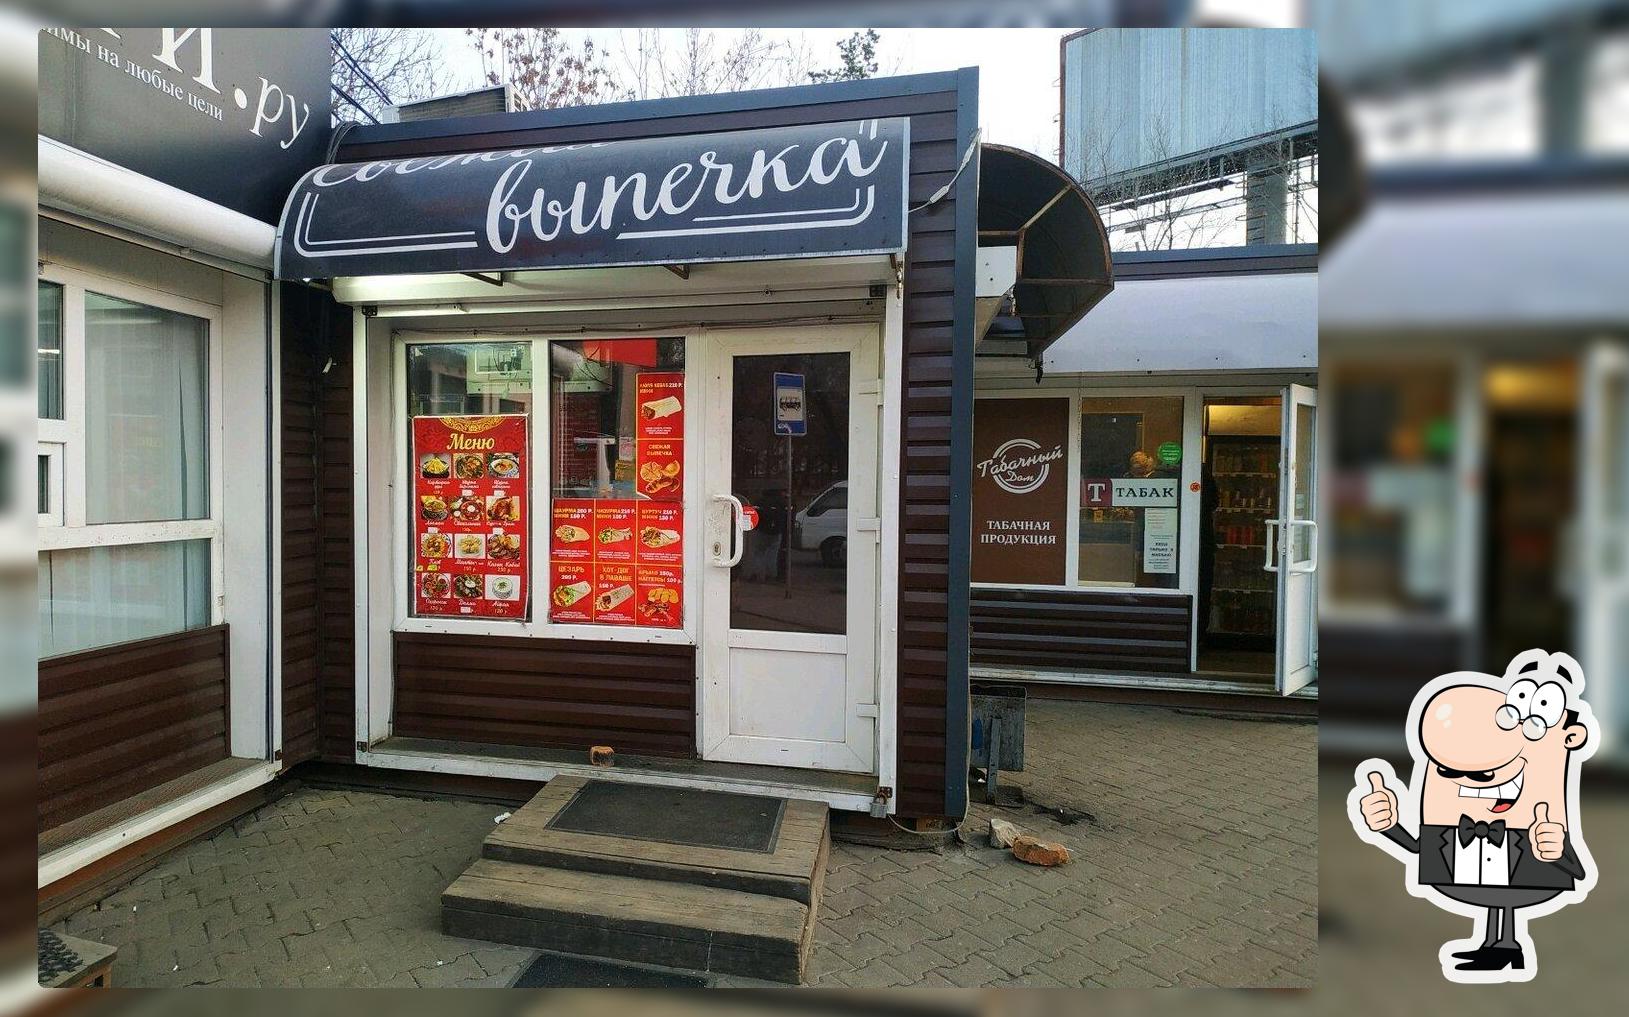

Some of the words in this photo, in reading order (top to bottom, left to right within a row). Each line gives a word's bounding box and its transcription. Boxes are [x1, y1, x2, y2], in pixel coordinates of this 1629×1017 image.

[97, 44, 120, 68] на
[125, 60, 184, 100] любые
[187, 91, 223, 122] цели
[447, 433, 495, 450] Меню
[977, 445, 1063, 477] Табачный
[1005, 470, 1034, 482] Дом
[1116, 487, 1175, 498] ТАБАК
[987, 520, 1050, 531] ТАБАЧНАЯ
[980, 534, 1057, 546] ПРОДУКЦИЯ
